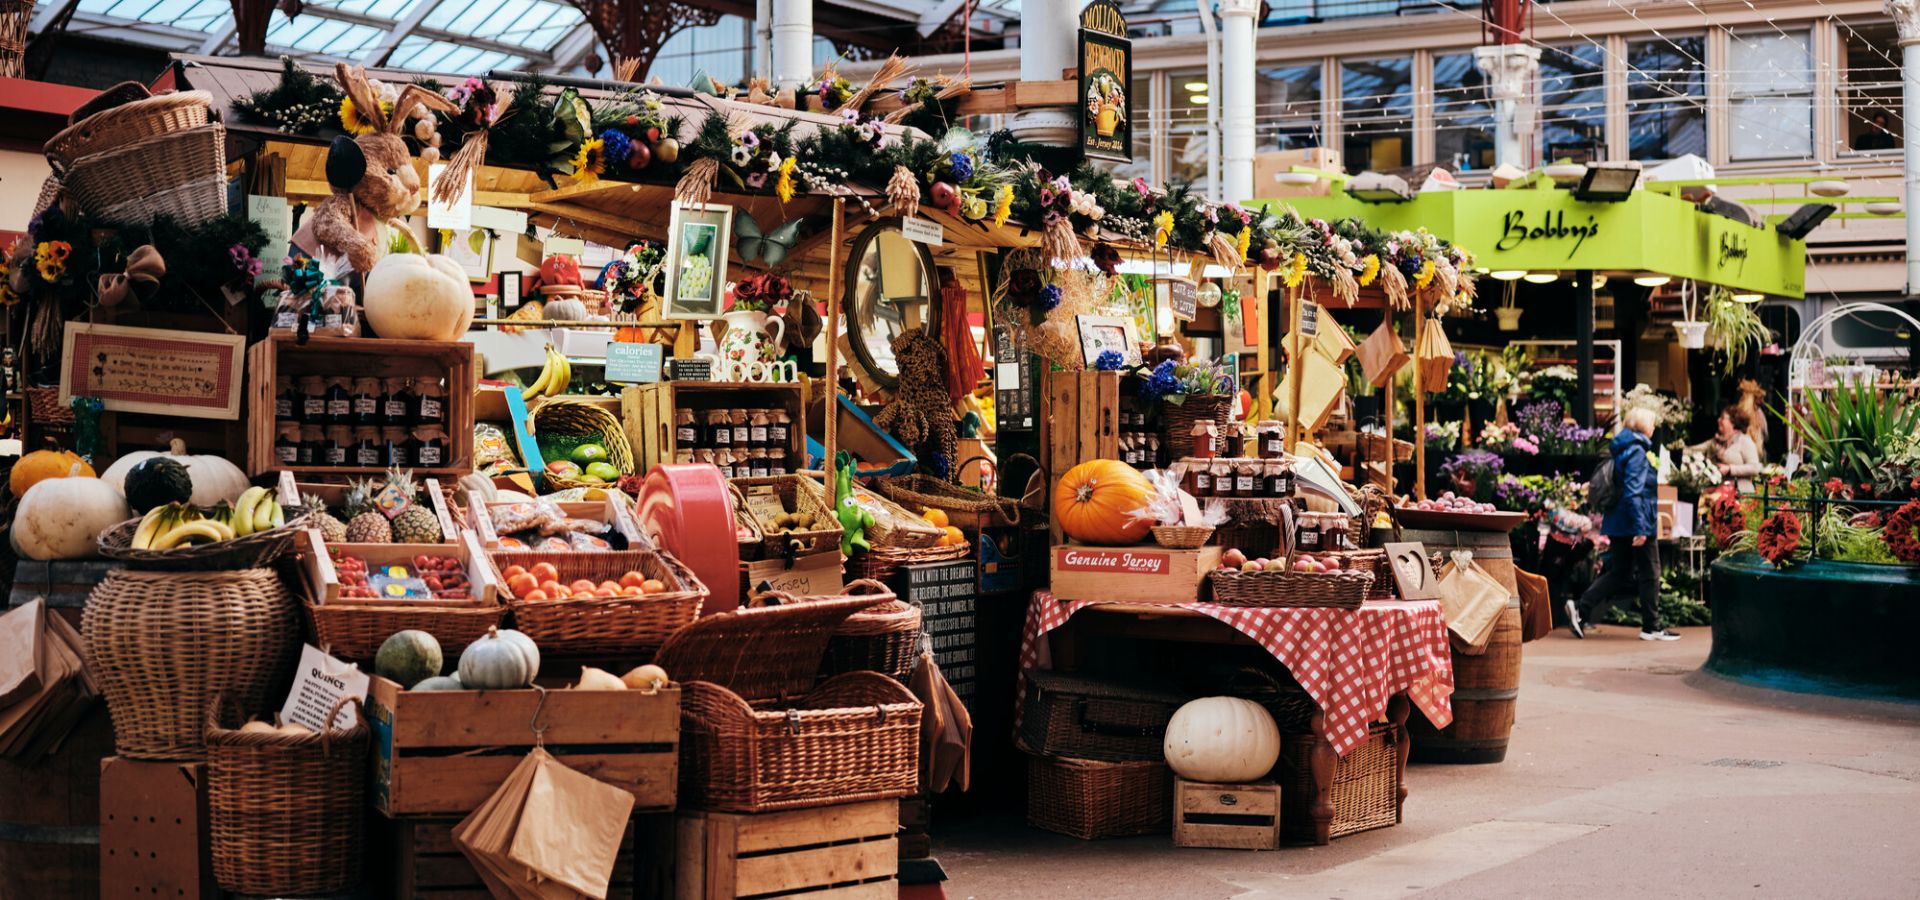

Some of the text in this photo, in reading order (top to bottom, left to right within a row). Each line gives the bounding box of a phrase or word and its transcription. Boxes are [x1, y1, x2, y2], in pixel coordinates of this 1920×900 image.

[1084, 3, 1126, 38] MOLLOY'S
[1097, 138, 1112, 150] Jersey
[1494, 210, 1599, 260] Bobby's
[1717, 230, 1748, 279] Bobby's
[1174, 281, 1187, 295] LOVE
[1180, 301, 1195, 315] LOVED
[615, 345, 653, 356] calories
[693, 353, 801, 383] Bloom
[1065, 551, 1162, 572] Genuine Jersey
[911, 569, 925, 583] WALK
[926, 569, 939, 582] WITH
[940, 568, 948, 581] THE
[911, 587, 919, 600] THE
[941, 585, 949, 598] THE
[939, 602, 947, 615] THE
[934, 617, 960, 632] SUCCESSFUL
[960, 615, 975, 630] PEOPLE
[311, 667, 347, 691] QUINCE
